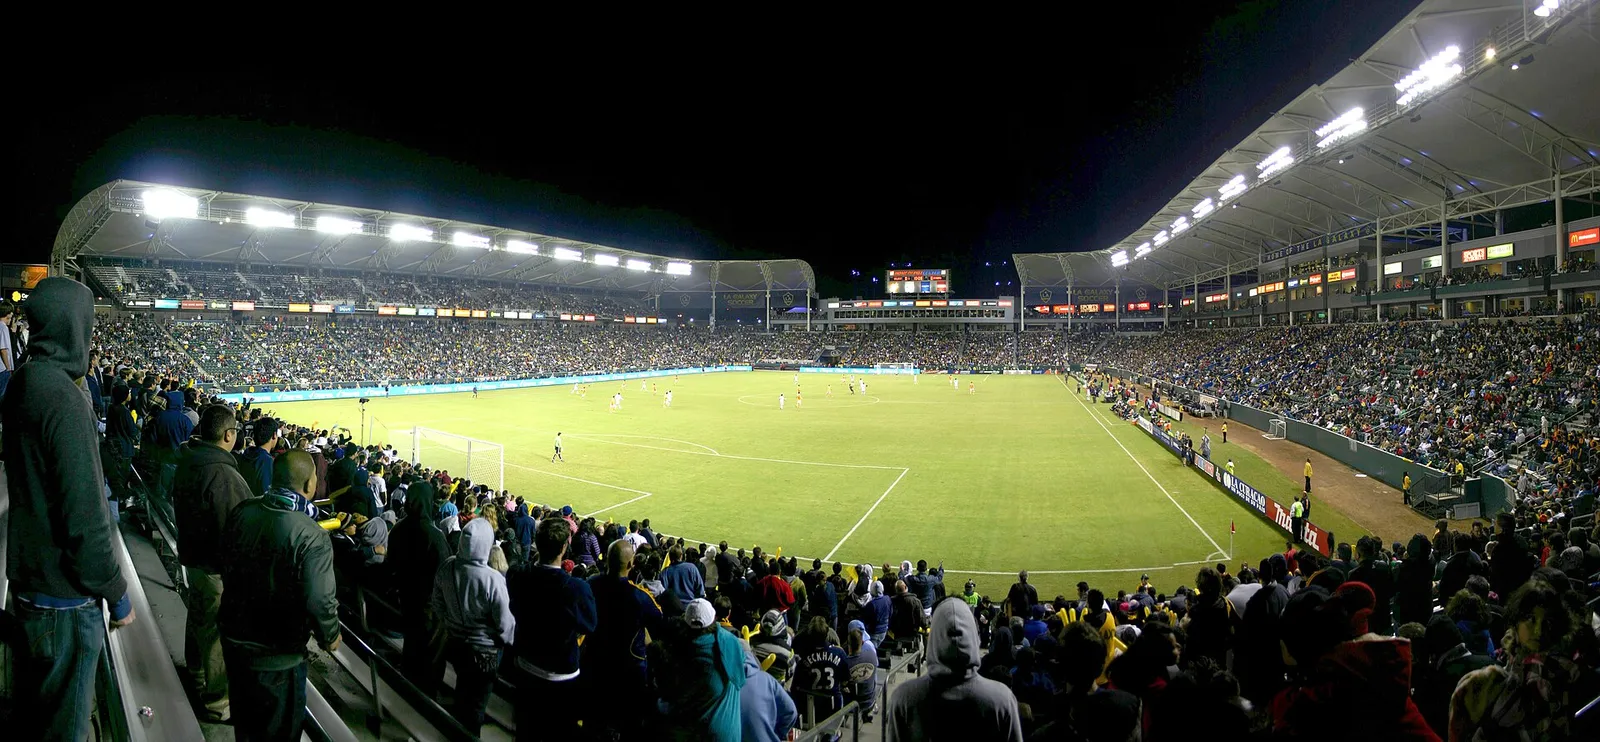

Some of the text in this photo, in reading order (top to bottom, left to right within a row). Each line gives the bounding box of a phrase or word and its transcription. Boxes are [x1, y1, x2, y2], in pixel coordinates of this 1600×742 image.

[1267, 250, 1283, 261] HOME
[1286, 247, 1293, 256] OF
[1297, 241, 1309, 252] THE
[1314, 238, 1322, 248] LA
[1231, 476, 1239, 491] LA
[1274, 502, 1320, 552] Maita
[803, 651, 841, 668] BECKHAM
[811, 666, 835, 690] 23
